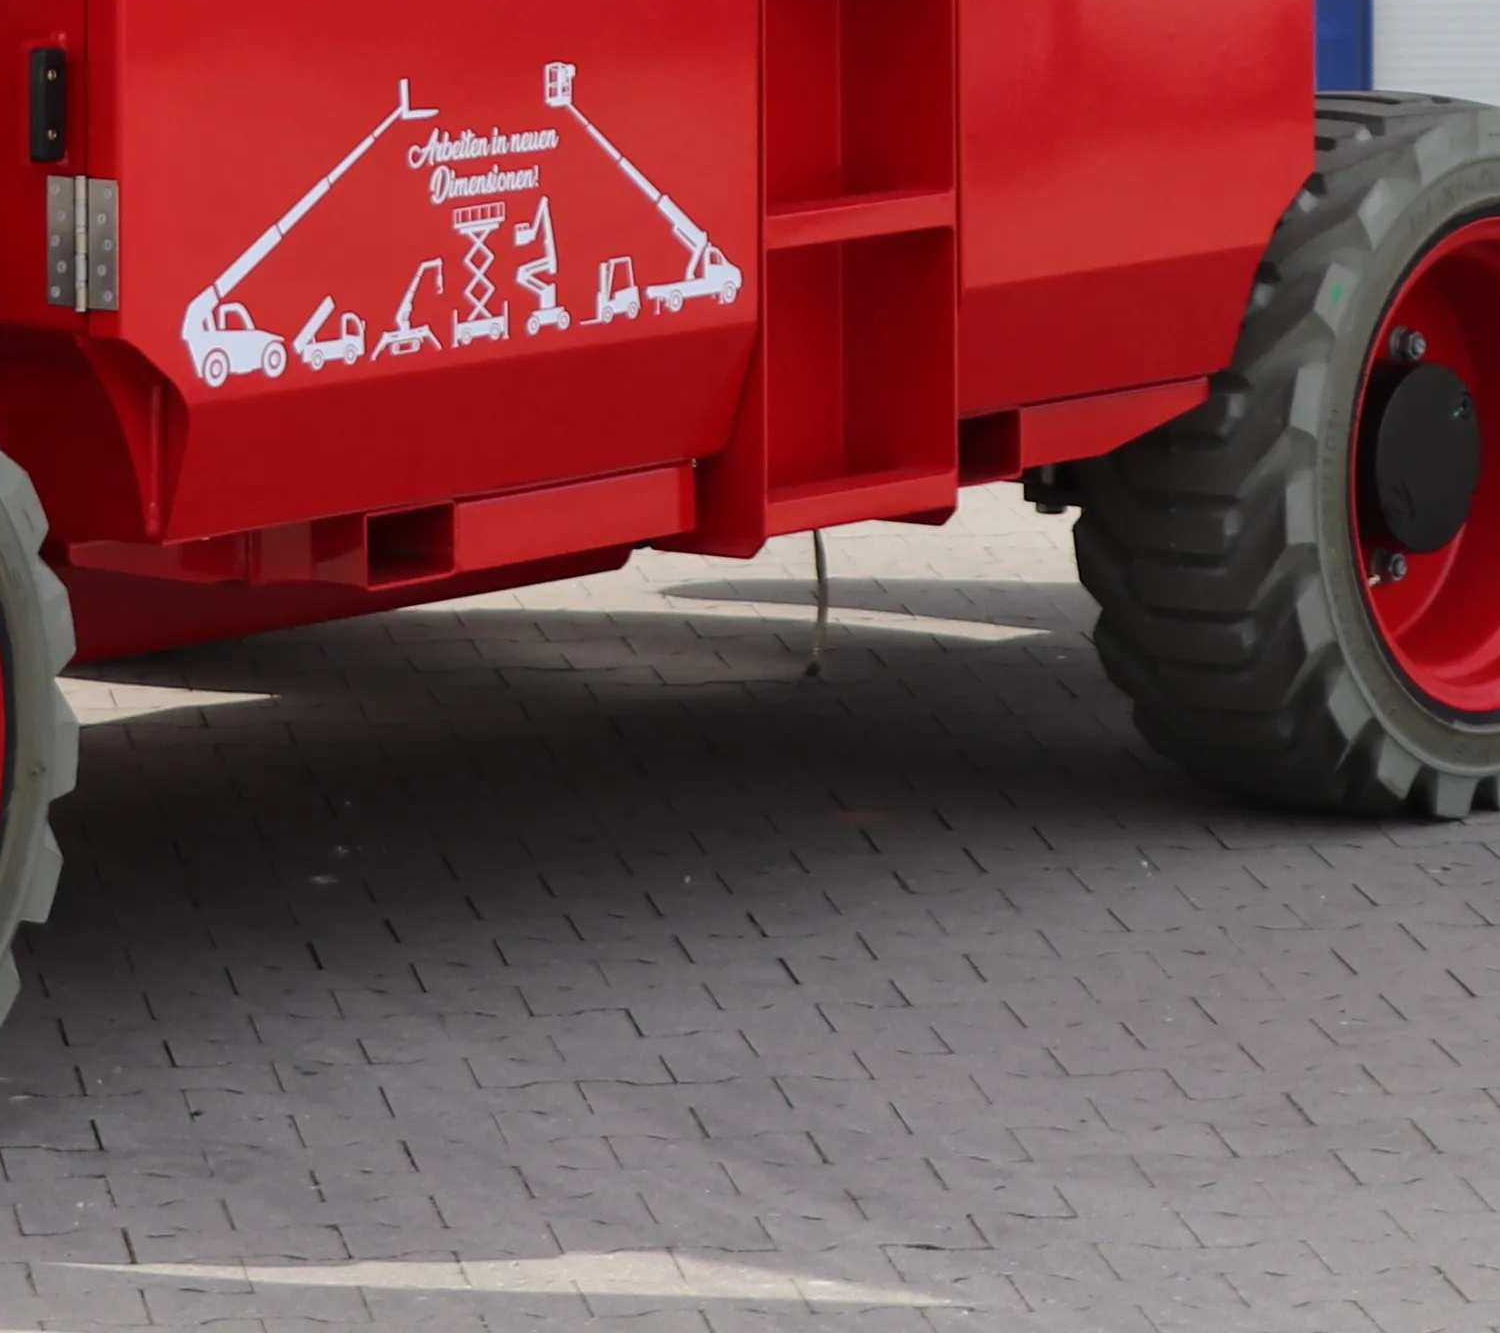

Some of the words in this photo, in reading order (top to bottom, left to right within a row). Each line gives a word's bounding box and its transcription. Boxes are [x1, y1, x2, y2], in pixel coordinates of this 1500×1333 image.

[408, 127, 490, 169] Arbeiten
[492, 126, 510, 155] in
[510, 128, 559, 155] neuen
[429, 164, 540, 205] Dimensionen!
